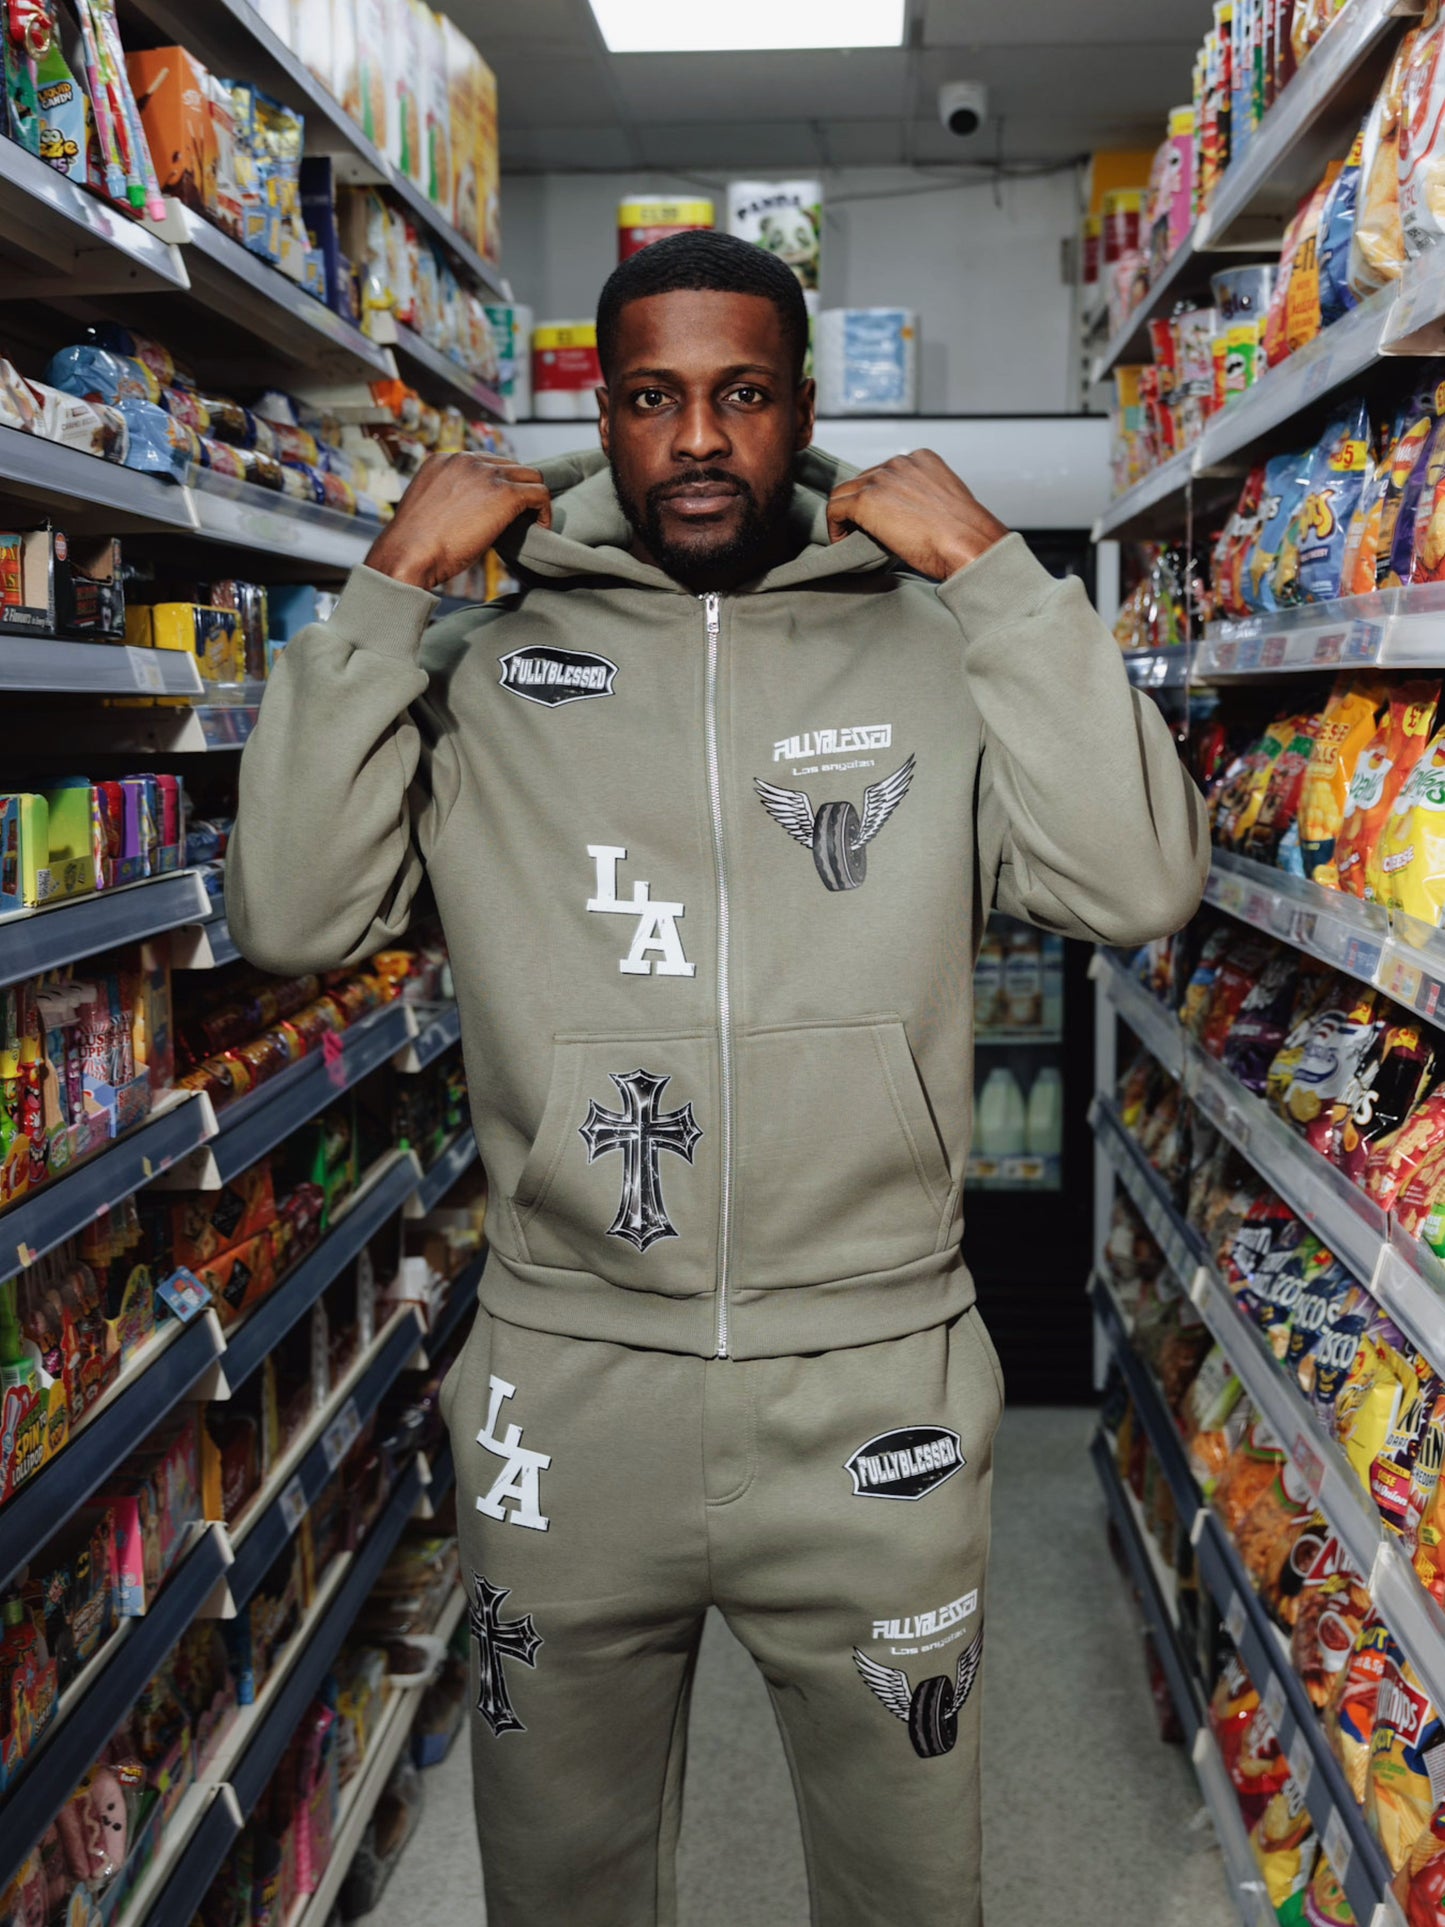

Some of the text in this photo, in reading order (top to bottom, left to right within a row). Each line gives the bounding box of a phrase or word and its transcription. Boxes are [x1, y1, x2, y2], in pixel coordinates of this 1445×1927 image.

[508, 656, 607, 690] FULLYBLESSED
[773, 723, 892, 762] FULLYBLESSED
[792, 766, 819, 776] Los
[587, 844, 696, 977] LA
[476, 1374, 552, 1532] LA
[856, 1435, 957, 1488] FULLYBLESSED
[872, 1588, 978, 1640] FULLYBLESSED
[891, 1647, 919, 1655] Los
